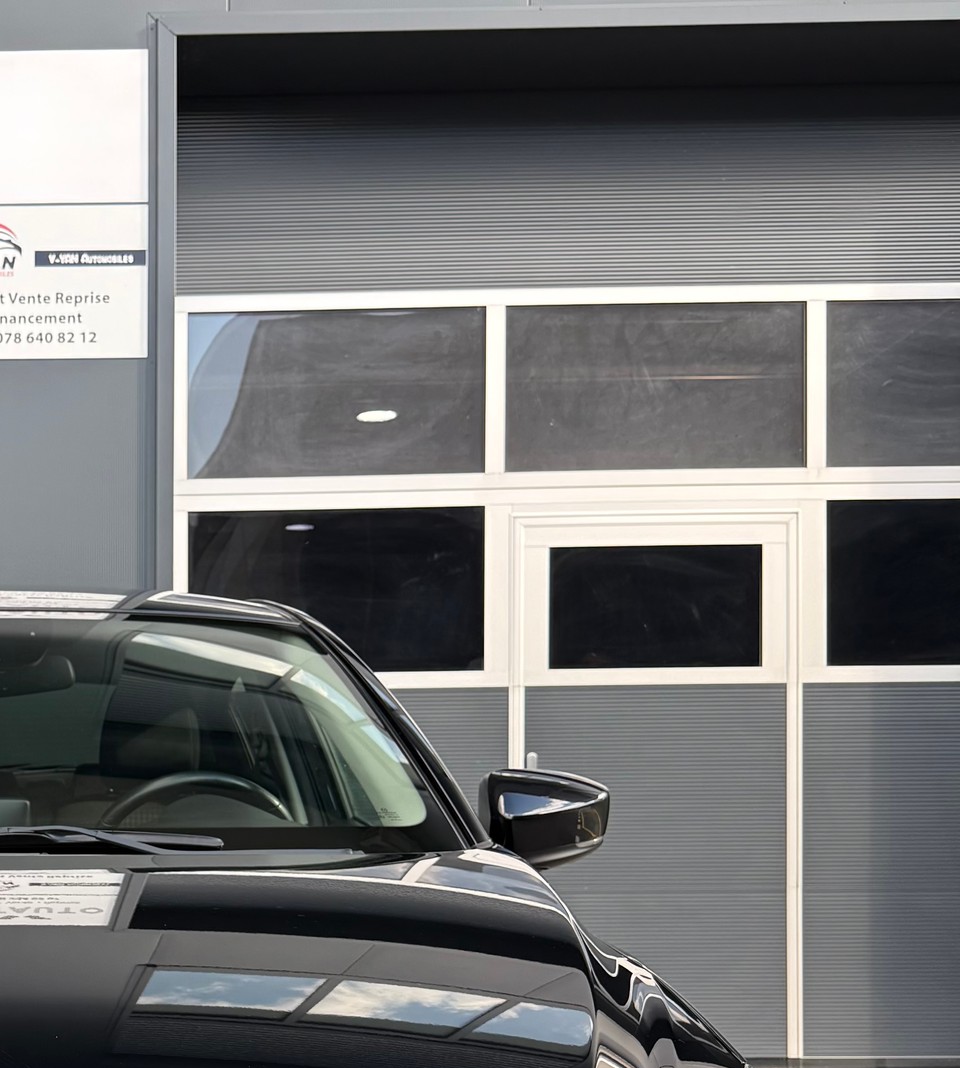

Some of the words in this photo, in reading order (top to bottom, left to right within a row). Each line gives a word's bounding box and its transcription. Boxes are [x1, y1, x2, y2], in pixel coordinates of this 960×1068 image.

[8, 292, 51, 304] Vente
[55, 291, 110, 307] Reprise
[26, 332, 53, 344] 640
[57, 332, 75, 343] 82
[81, 332, 97, 343] 12
